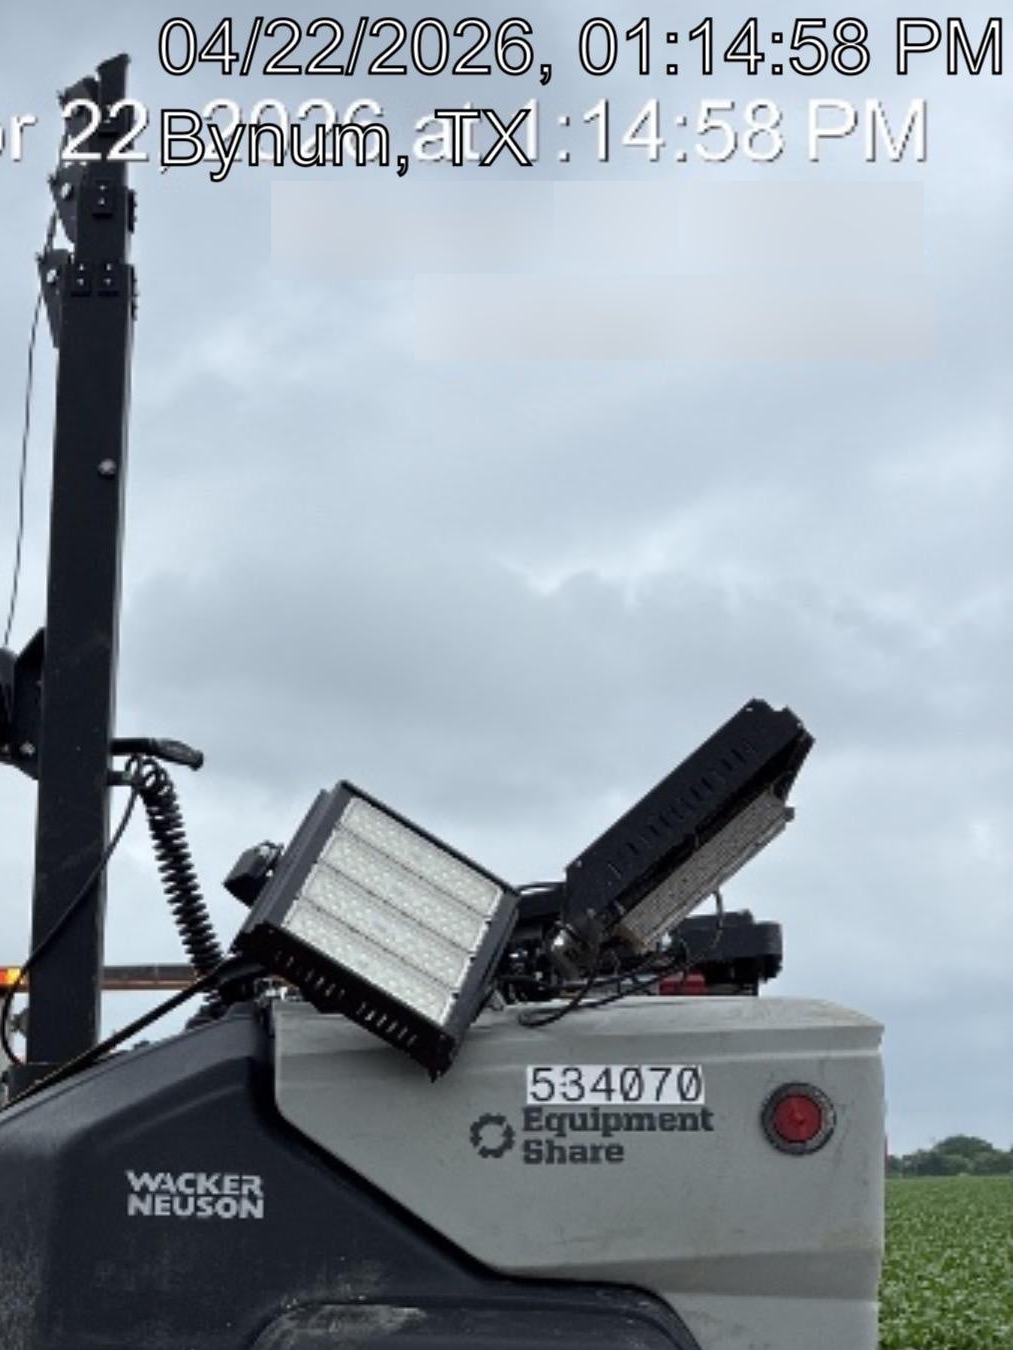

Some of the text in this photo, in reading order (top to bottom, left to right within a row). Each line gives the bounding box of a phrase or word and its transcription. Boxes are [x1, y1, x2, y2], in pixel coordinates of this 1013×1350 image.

[528, 1066, 703, 1102] 534070
[522, 1107, 714, 1138] Equipment
[522, 1140, 625, 1164] Share
[126, 1170, 264, 1197] WACKER
[126, 1196, 264, 1219] NEUSON
